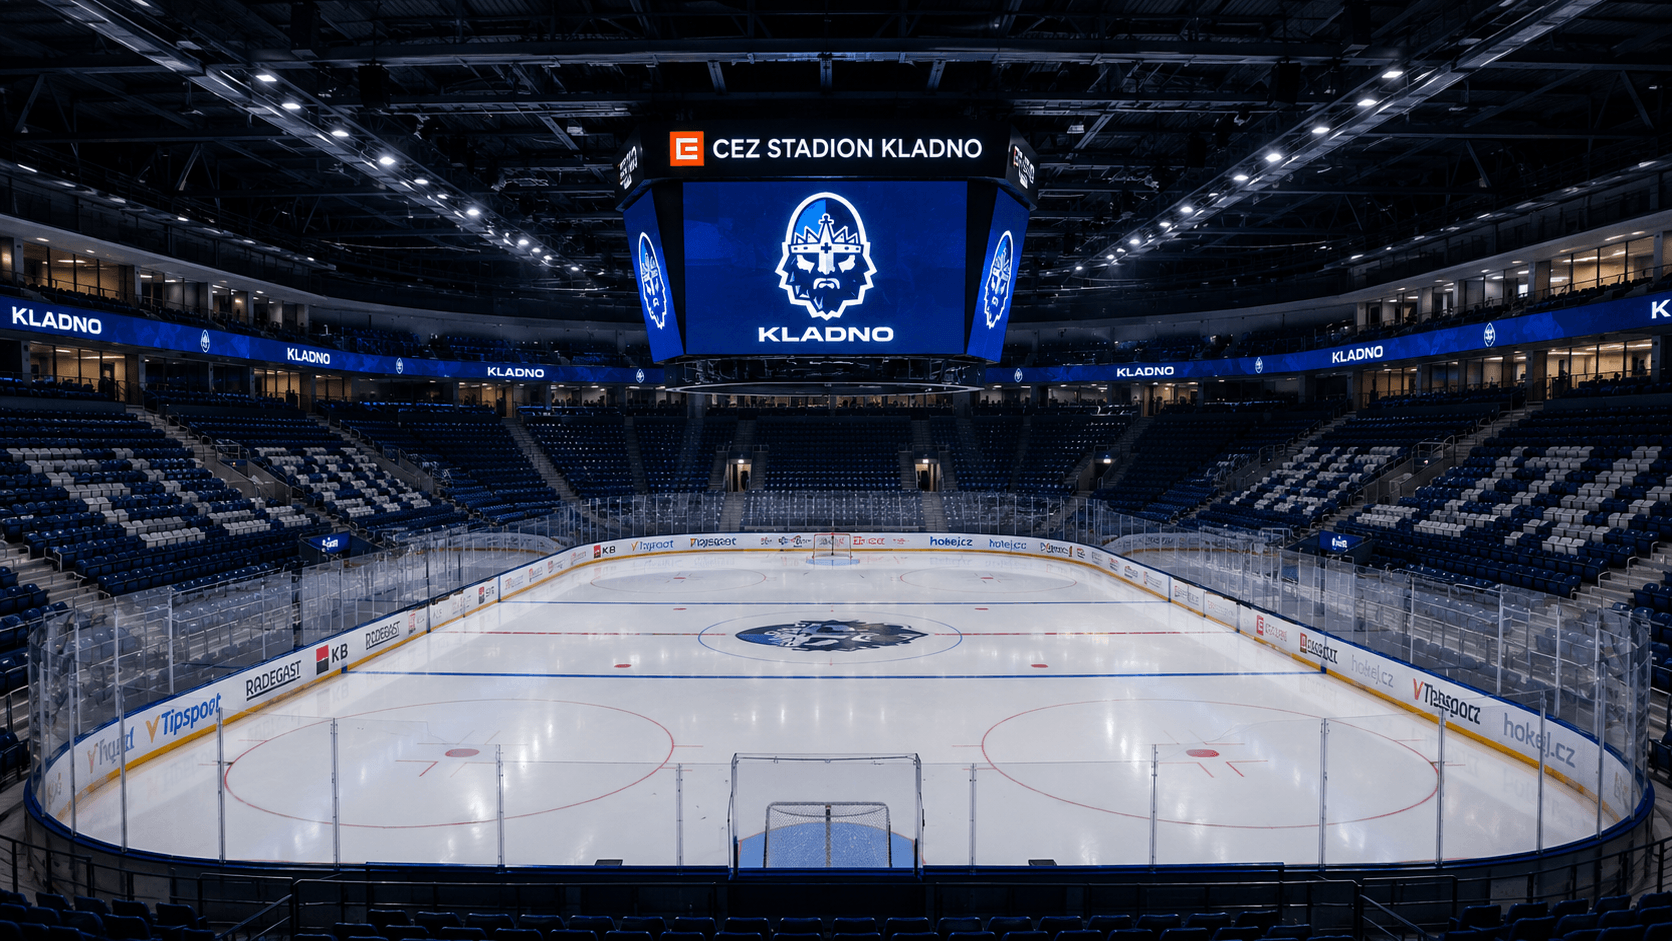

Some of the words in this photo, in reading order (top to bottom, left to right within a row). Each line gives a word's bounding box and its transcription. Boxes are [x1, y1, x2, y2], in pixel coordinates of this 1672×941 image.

[713, 138, 760, 158] CEZ
[767, 138, 873, 158] STADION
[881, 138, 983, 158] KLADNO
[11, 306, 102, 335] KLADNO
[758, 326, 894, 342] KLADNO
[286, 347, 331, 365] KLADNO
[1331, 345, 1384, 363] KLADNO
[487, 366, 545, 378] KLADNO
[1116, 366, 1175, 377] KLADNO
[331, 643, 349, 664] KB
[246, 660, 302, 697] RADEGAST
